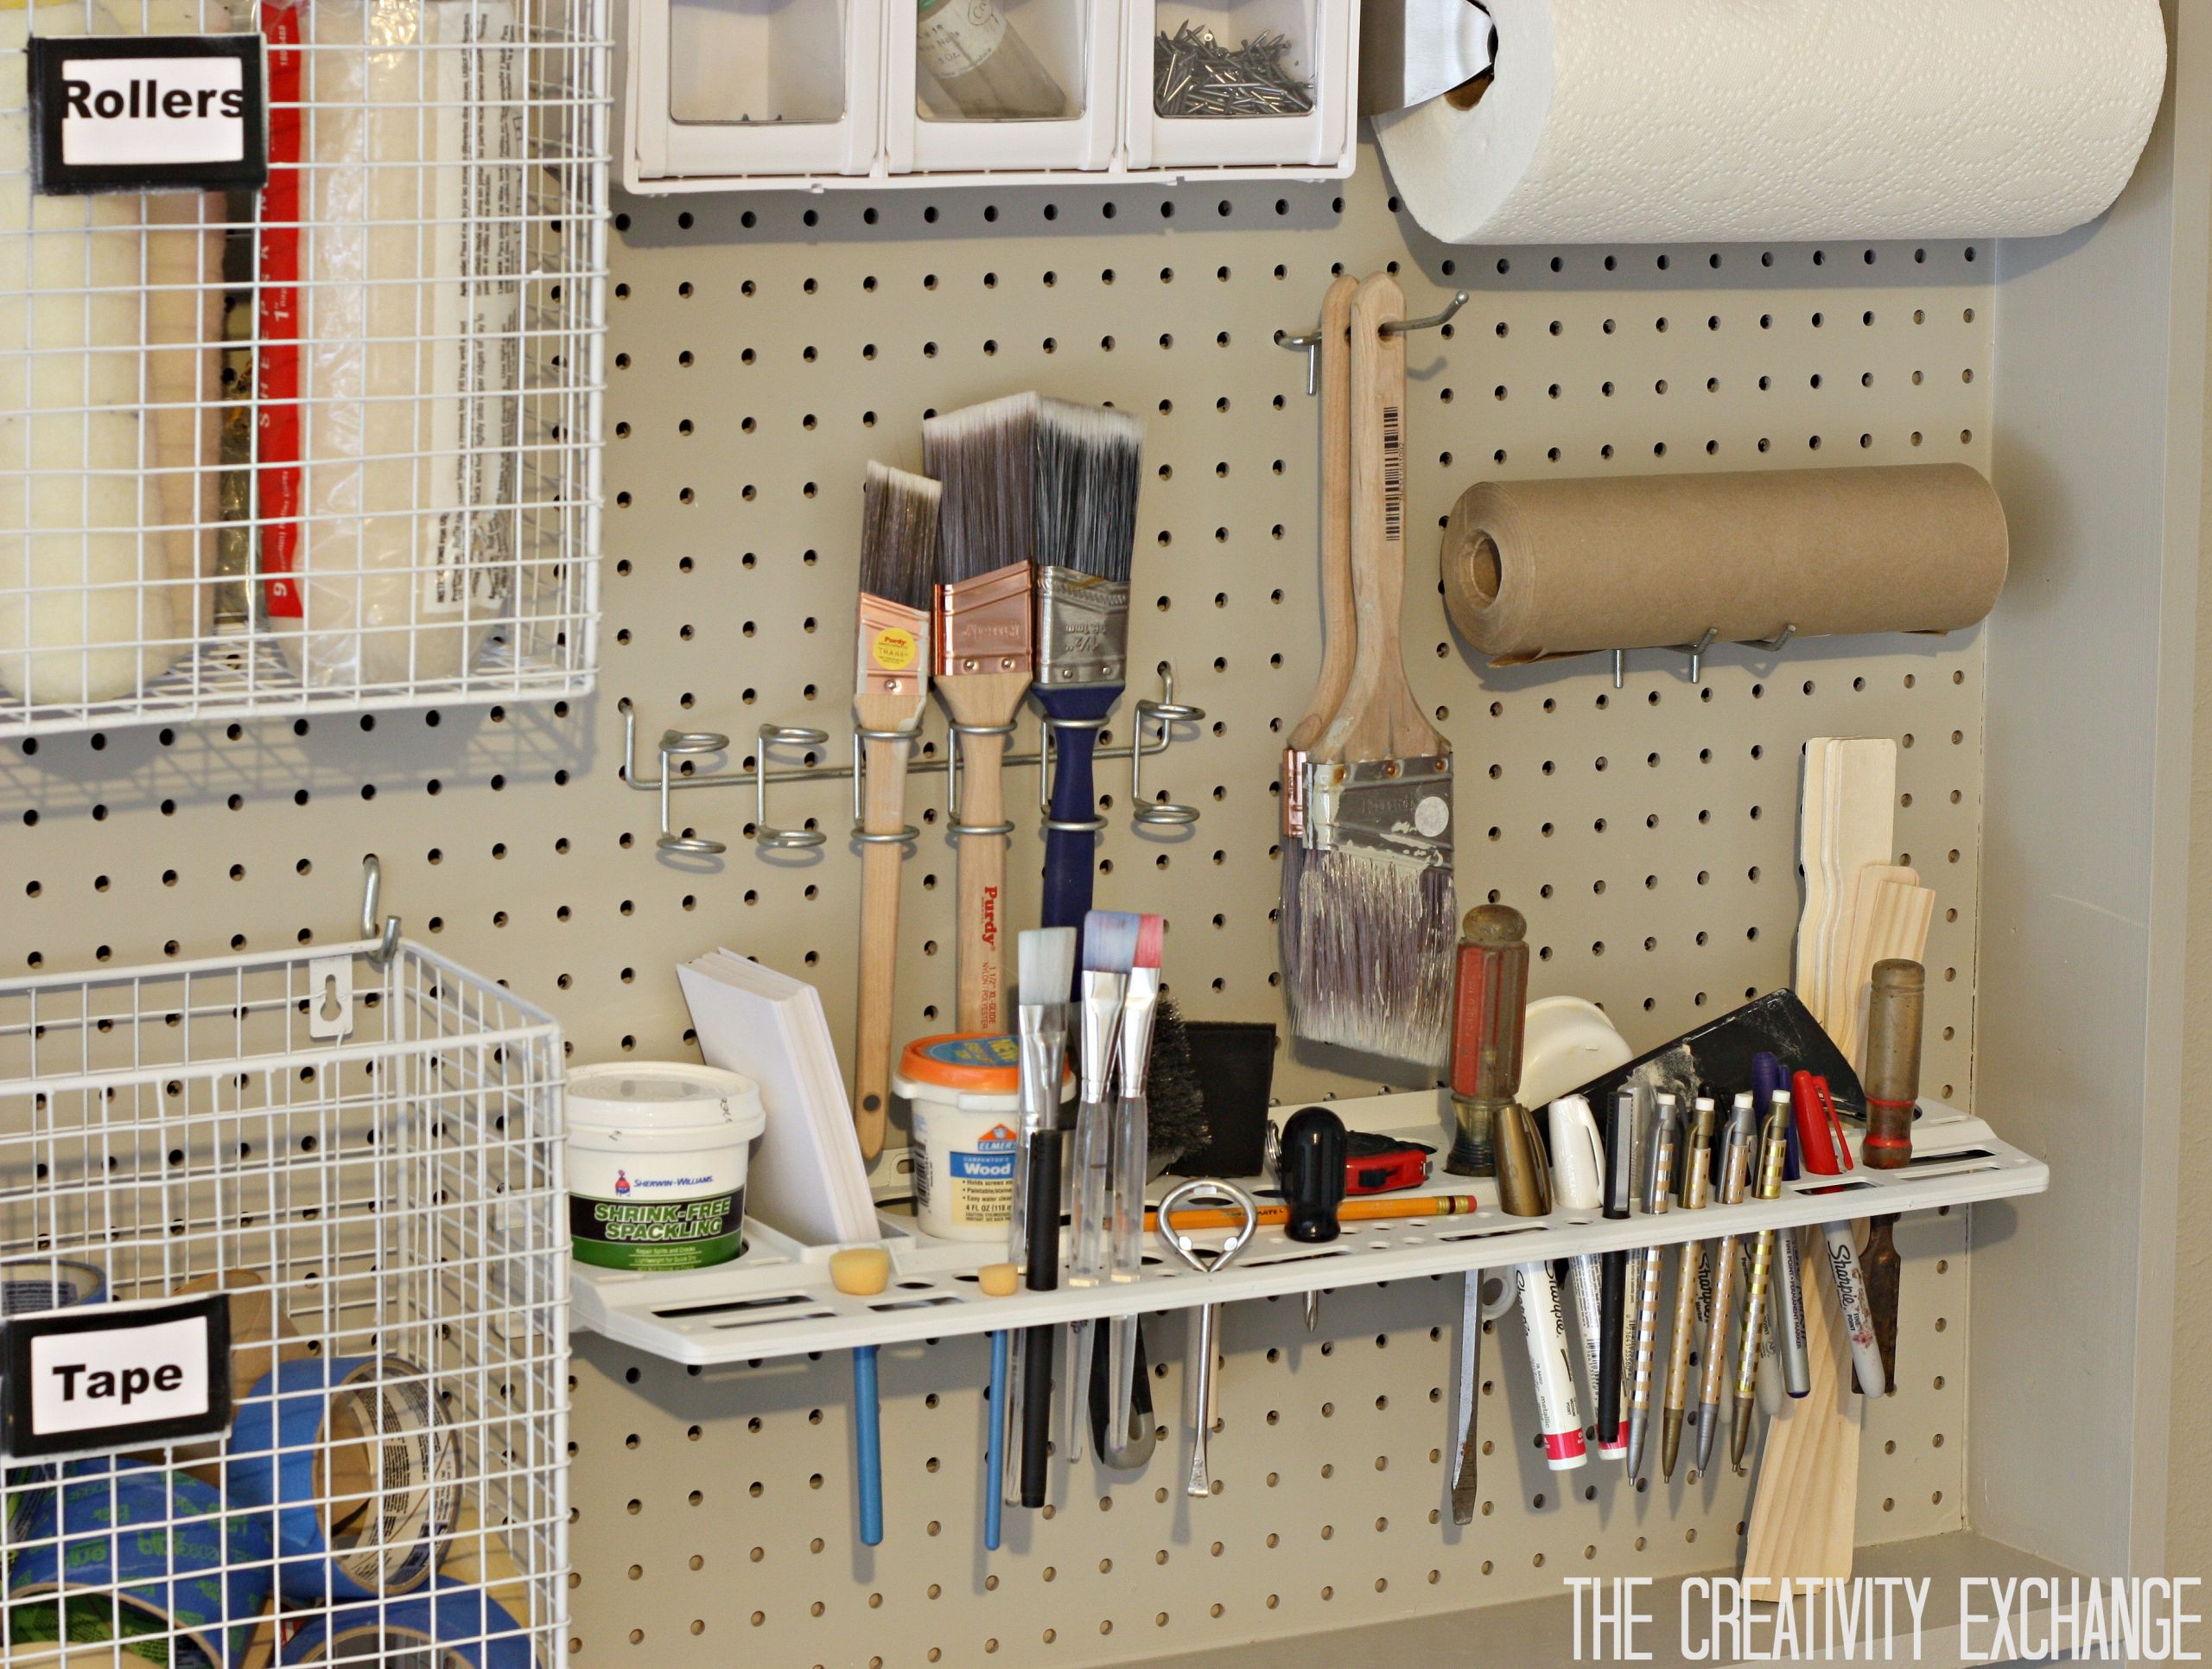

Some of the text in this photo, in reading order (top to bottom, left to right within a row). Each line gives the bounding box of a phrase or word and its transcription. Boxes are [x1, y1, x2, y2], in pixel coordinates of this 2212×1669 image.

[62, 80, 243, 119] Rollers
[982, 886, 998, 946] Purdy
[963, 1163, 1011, 1175] Wood
[594, 1197, 732, 1223] SHRINK-FREE
[605, 1219, 722, 1241] SPACKLING
[1827, 1241, 1855, 1308] Sharpie
[1793, 1319, 1802, 1350] MARKER
[1847, 1314, 1856, 1331] POINT
[52, 1364, 183, 1405] Tape
[1541, 1396, 1551, 1429] metallic
